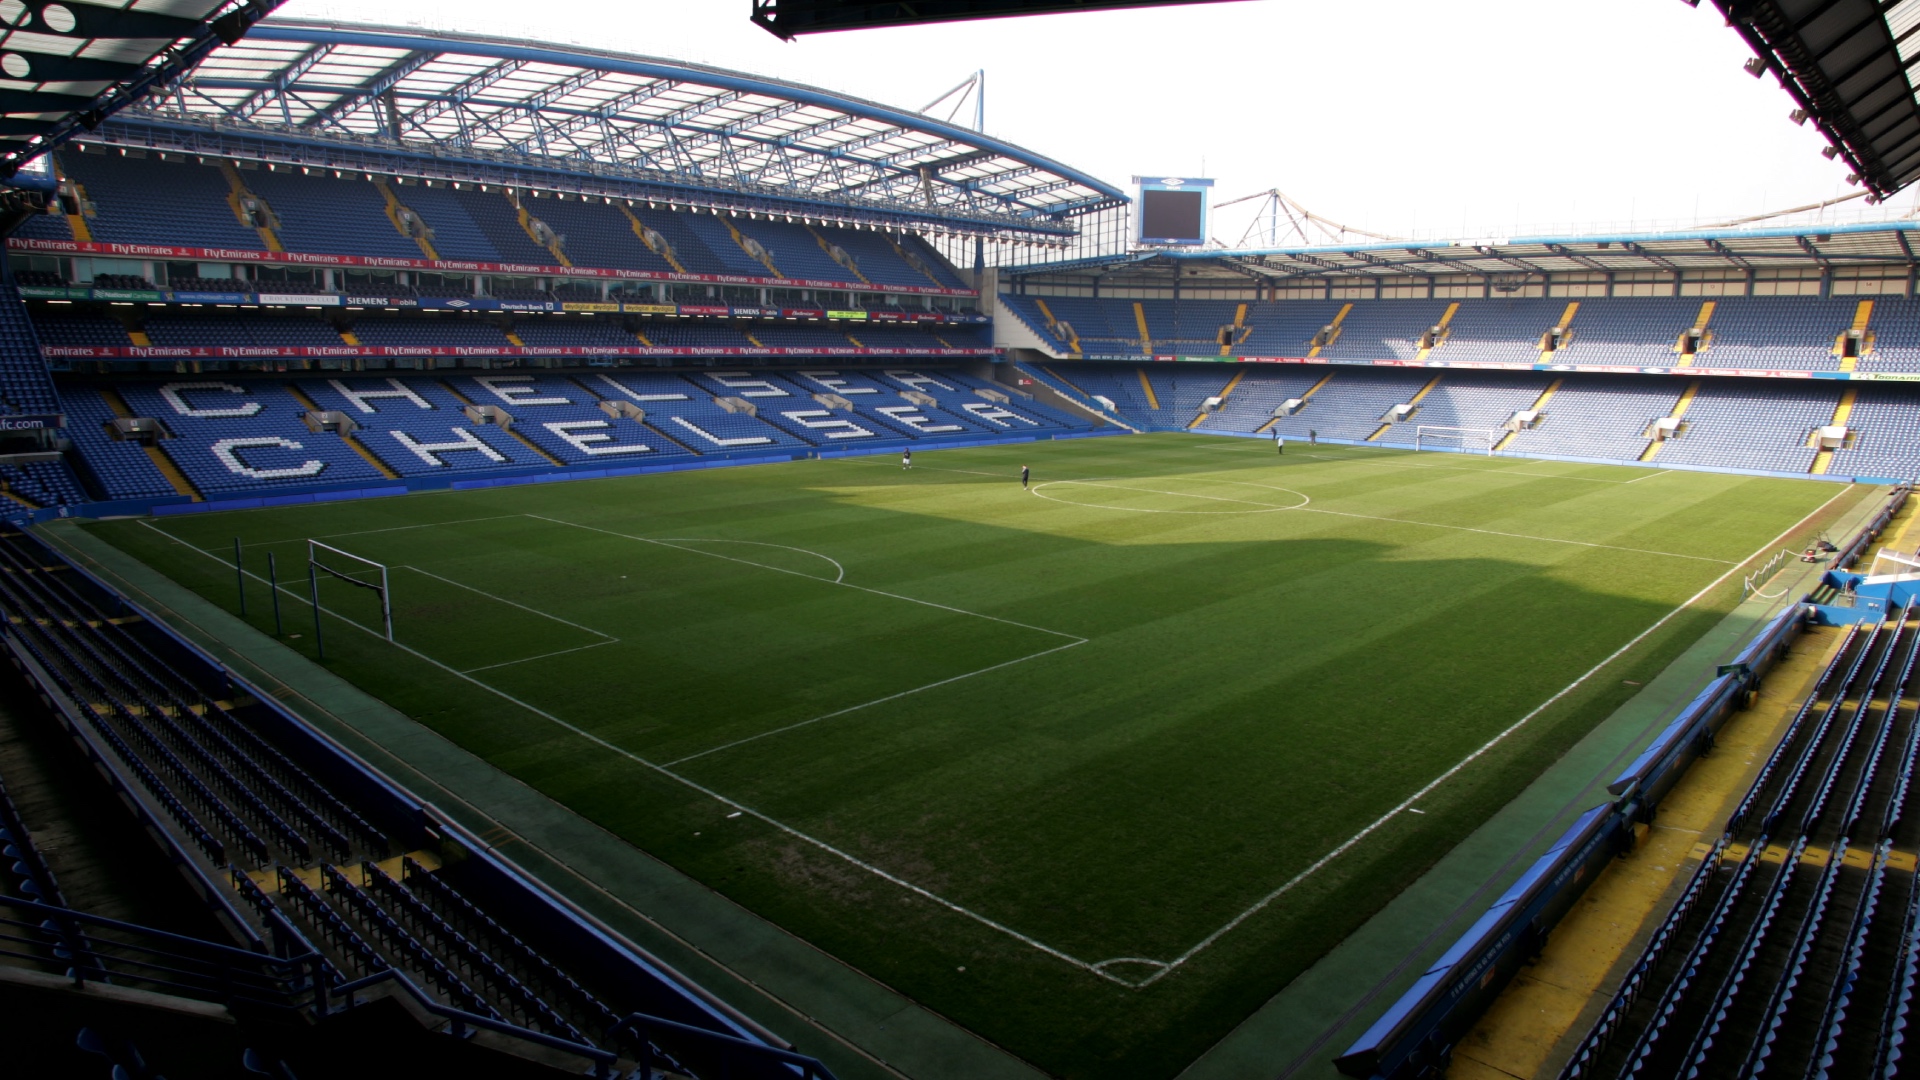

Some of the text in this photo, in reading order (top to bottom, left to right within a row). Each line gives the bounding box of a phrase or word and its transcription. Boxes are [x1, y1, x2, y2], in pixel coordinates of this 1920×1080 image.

[9, 238, 78, 250] Fly Emirates
[112, 244, 172, 255] Fly Emirates
[204, 249, 260, 259] Fly Emirates
[288, 252, 338, 263] Fly Emirates
[365, 257, 410, 266] Fly Emirates
[435, 261, 478, 270] Fly Emirates
[500, 264, 540, 272] Fly Emirates
[560, 266, 598, 276] Fly Emirates
[616, 270, 626, 278] Fly
[347, 298, 388, 306] SIEMENS
[46, 347, 94, 356] Emirates
[130, 348, 191, 357] Fly Emirates
[223, 348, 279, 357] Fly Emirates
[307, 348, 322, 356] Fly
[385, 348, 398, 356] Fly
[456, 348, 468, 356] Fly
[0, 419, 44, 430] fc.com
[211, 403, 1039, 479] CHELSEA
